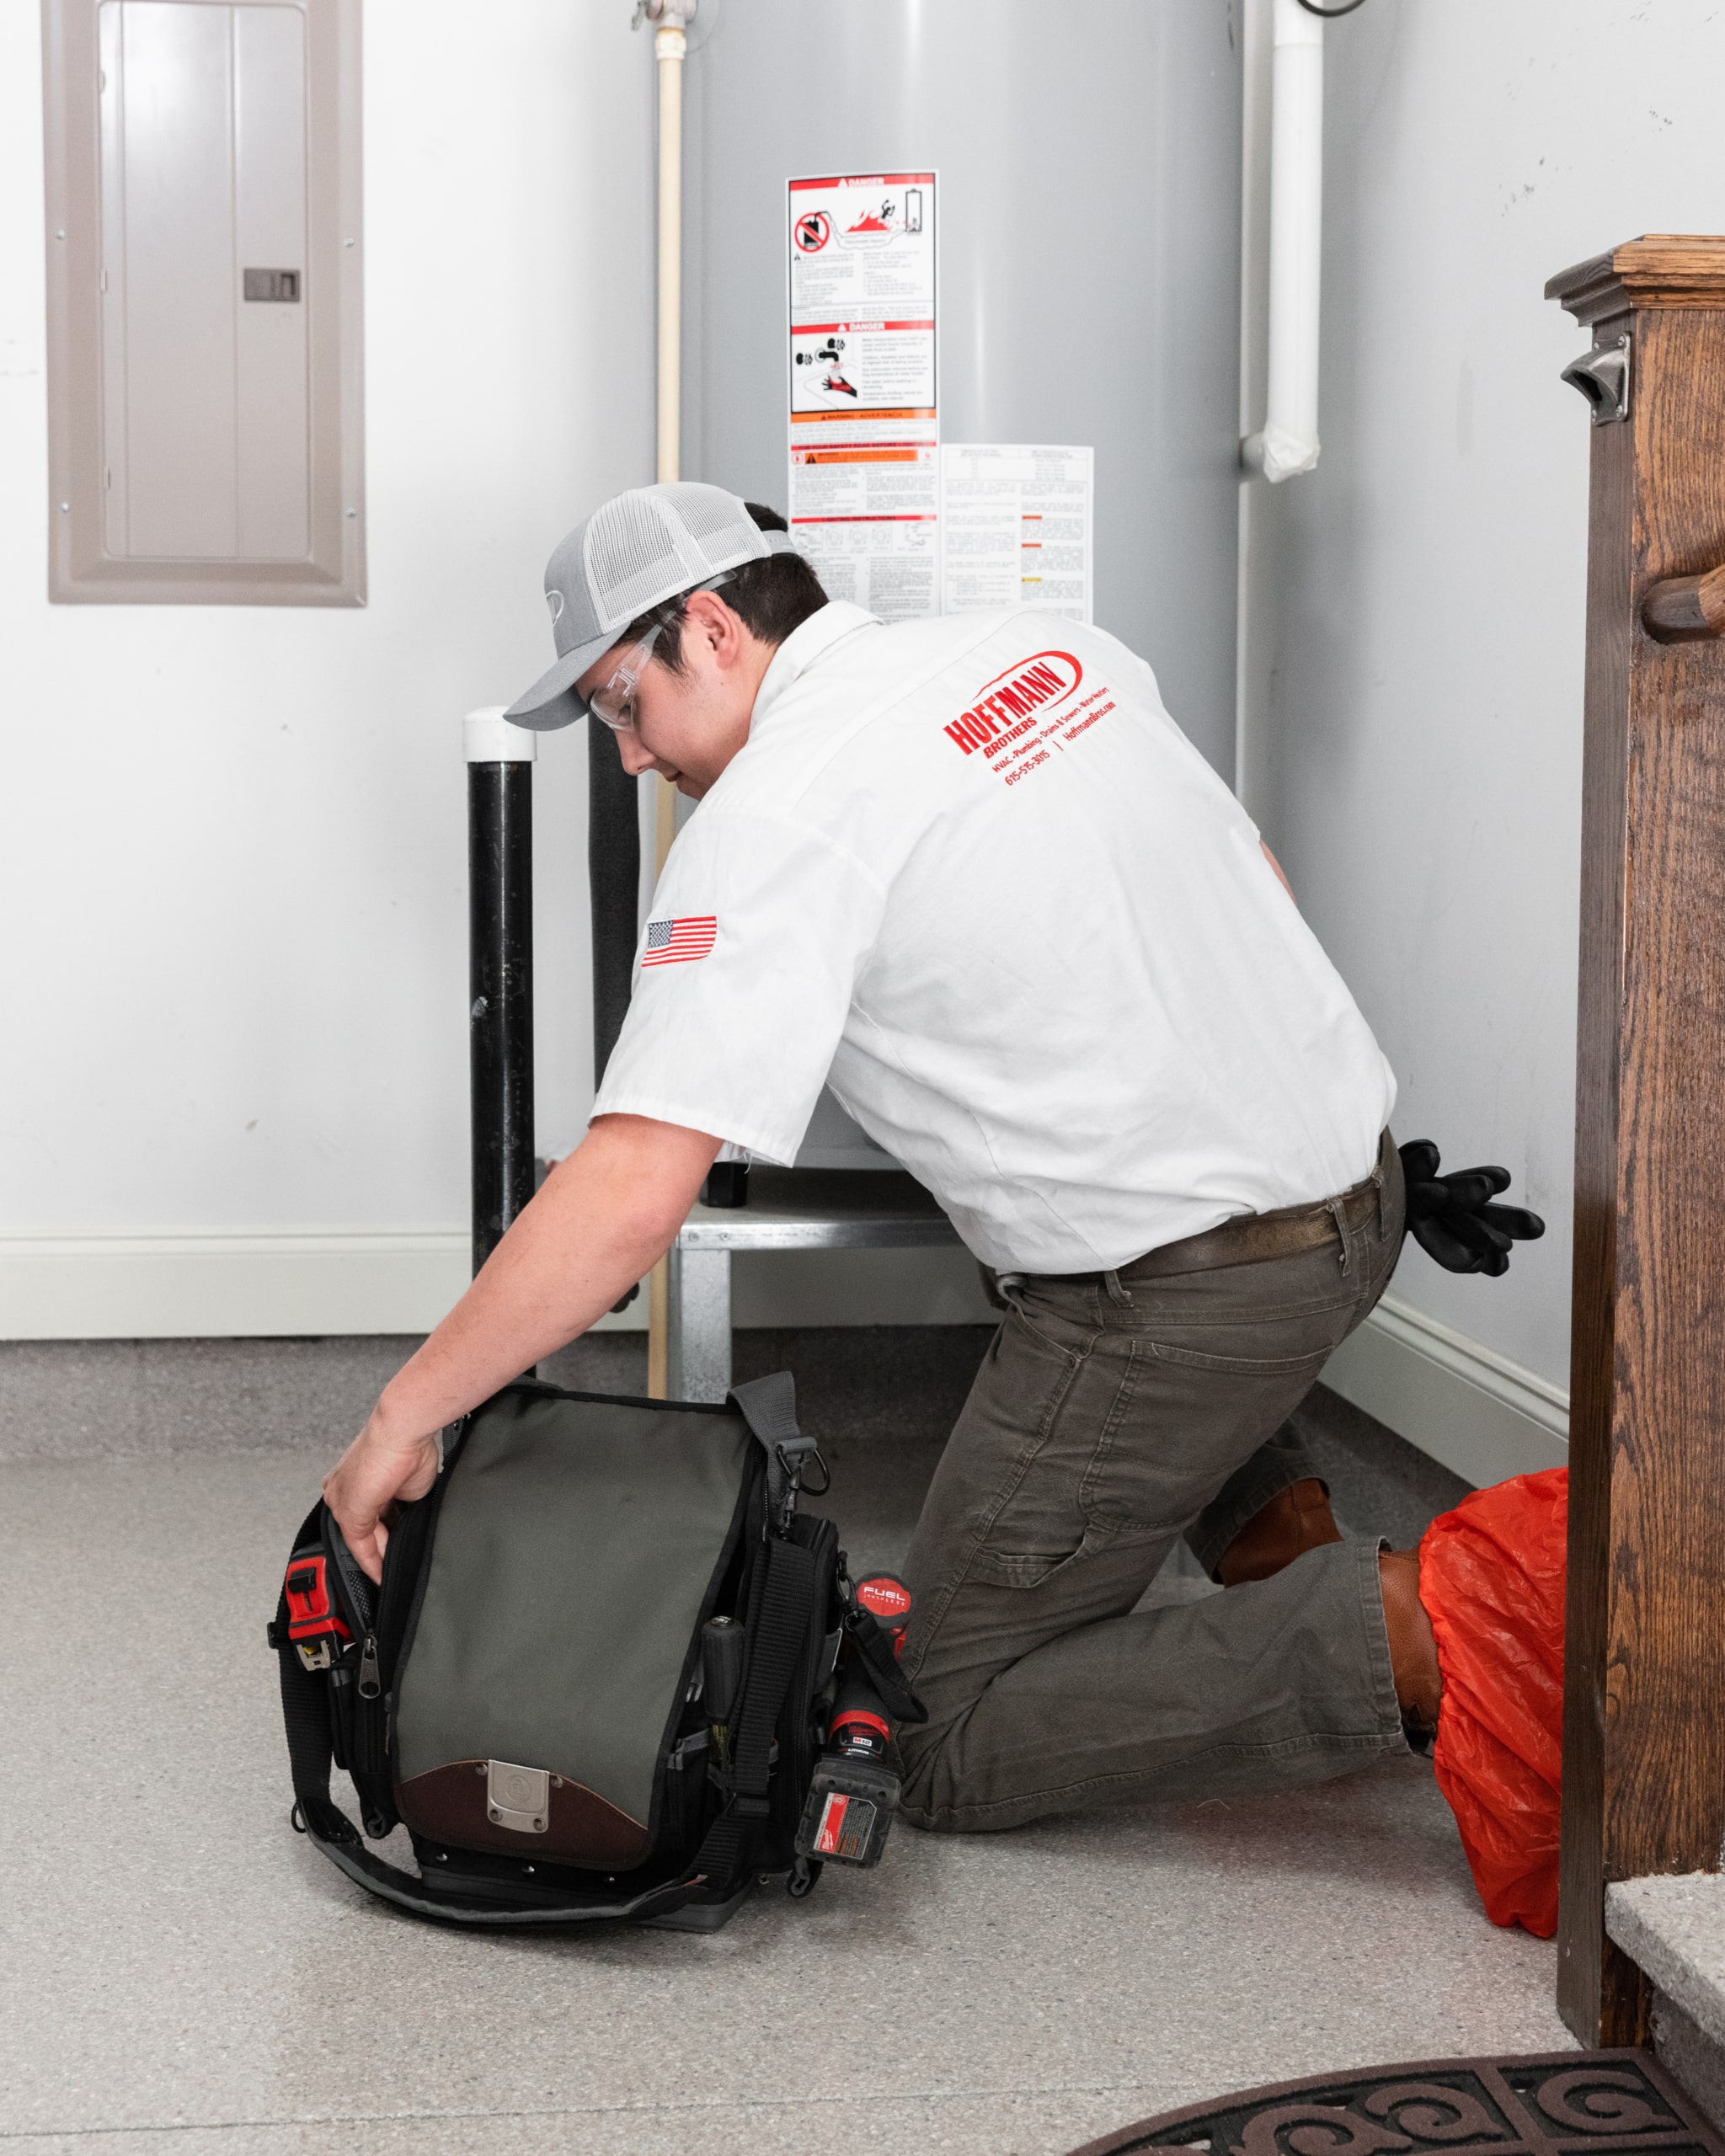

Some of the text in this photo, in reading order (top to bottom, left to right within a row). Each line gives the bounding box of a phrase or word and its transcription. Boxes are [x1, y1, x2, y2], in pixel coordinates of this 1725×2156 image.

[848, 177, 884, 187] DANGER
[848, 323, 885, 332] DANGER
[943, 661, 1066, 755] HOFFMANN
[982, 717, 1037, 760] BROTHERS
[991, 756, 1013, 773] HVAC
[1012, 738, 1043, 757] Plumbing
[1039, 724, 1060, 737] Drains
[1060, 707, 1081, 723] Sewers
[1091, 687, 1110, 699] Heaters
[1005, 702, 1117, 786] 615-515-3015 HoffmannBros.com
[864, 1587, 905, 1601] FUEL
